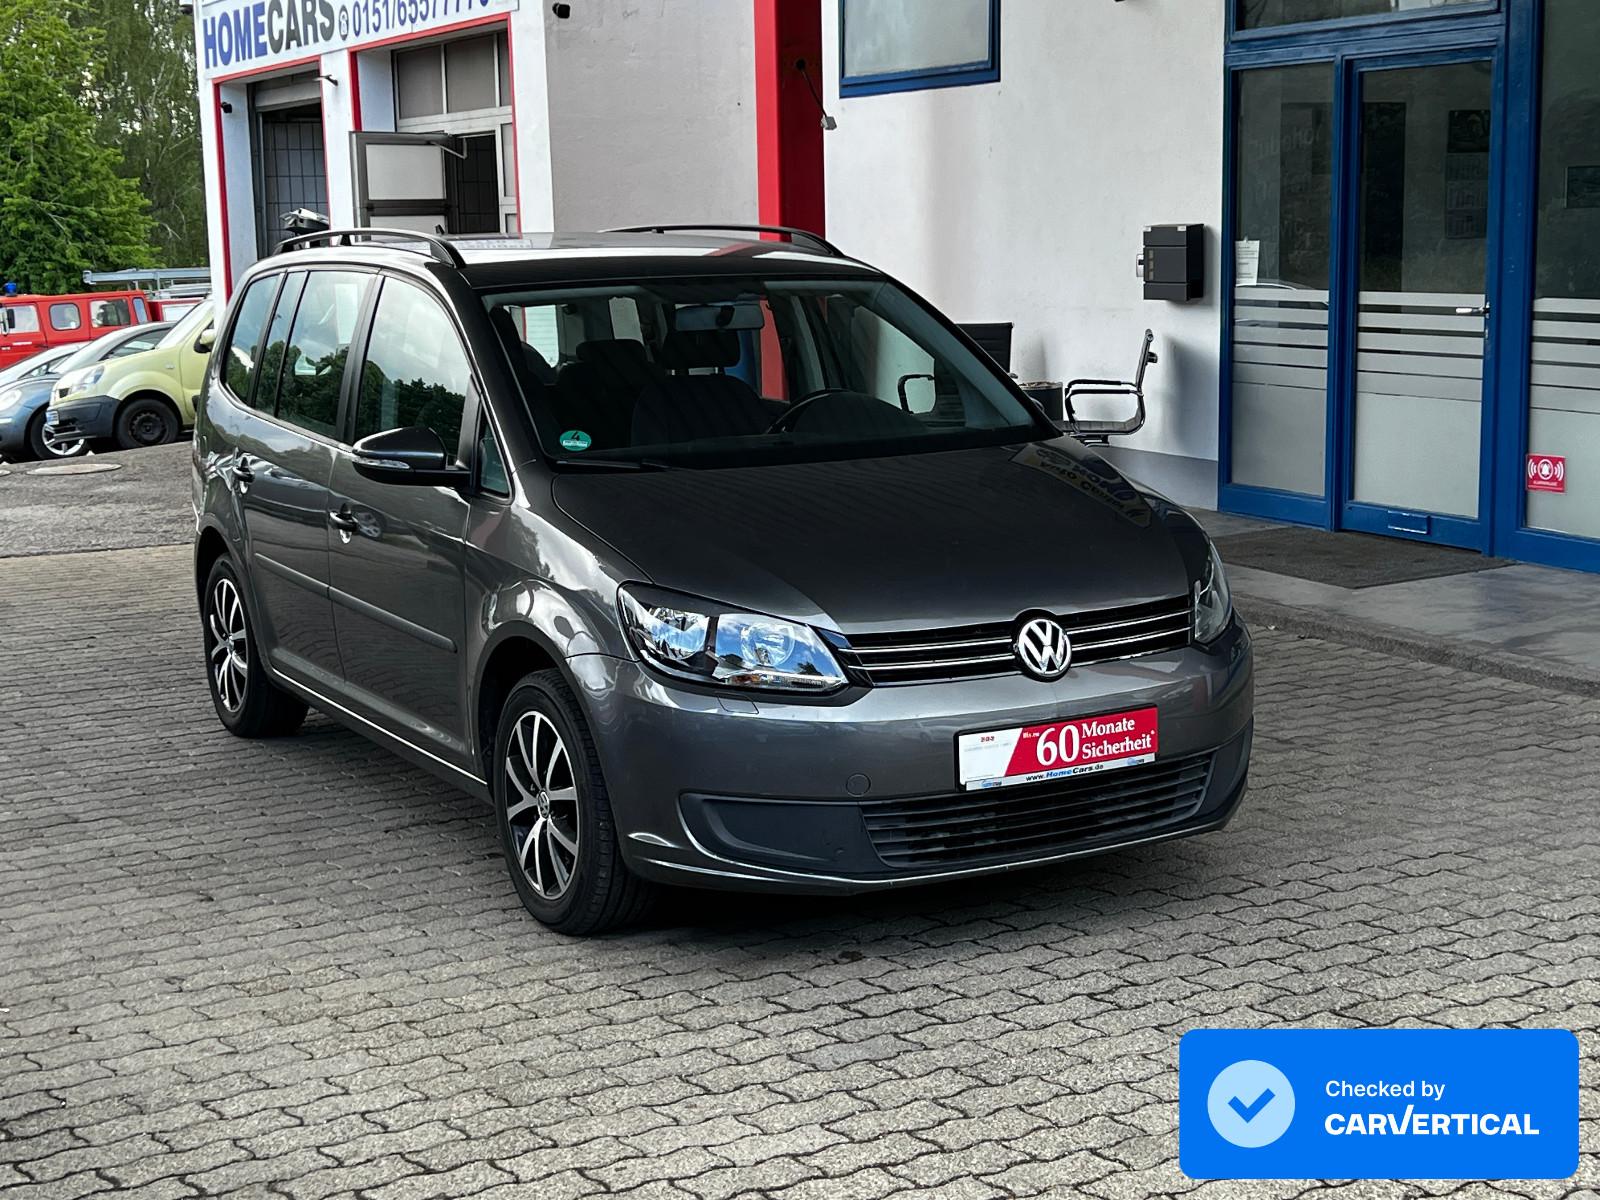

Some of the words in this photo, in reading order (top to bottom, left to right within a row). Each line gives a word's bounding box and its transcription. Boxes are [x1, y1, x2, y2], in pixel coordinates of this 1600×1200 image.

[203, 0, 335, 69] HOMECARS
[1036, 725, 1079, 766] 60
[1081, 718, 1135, 738] Monate
